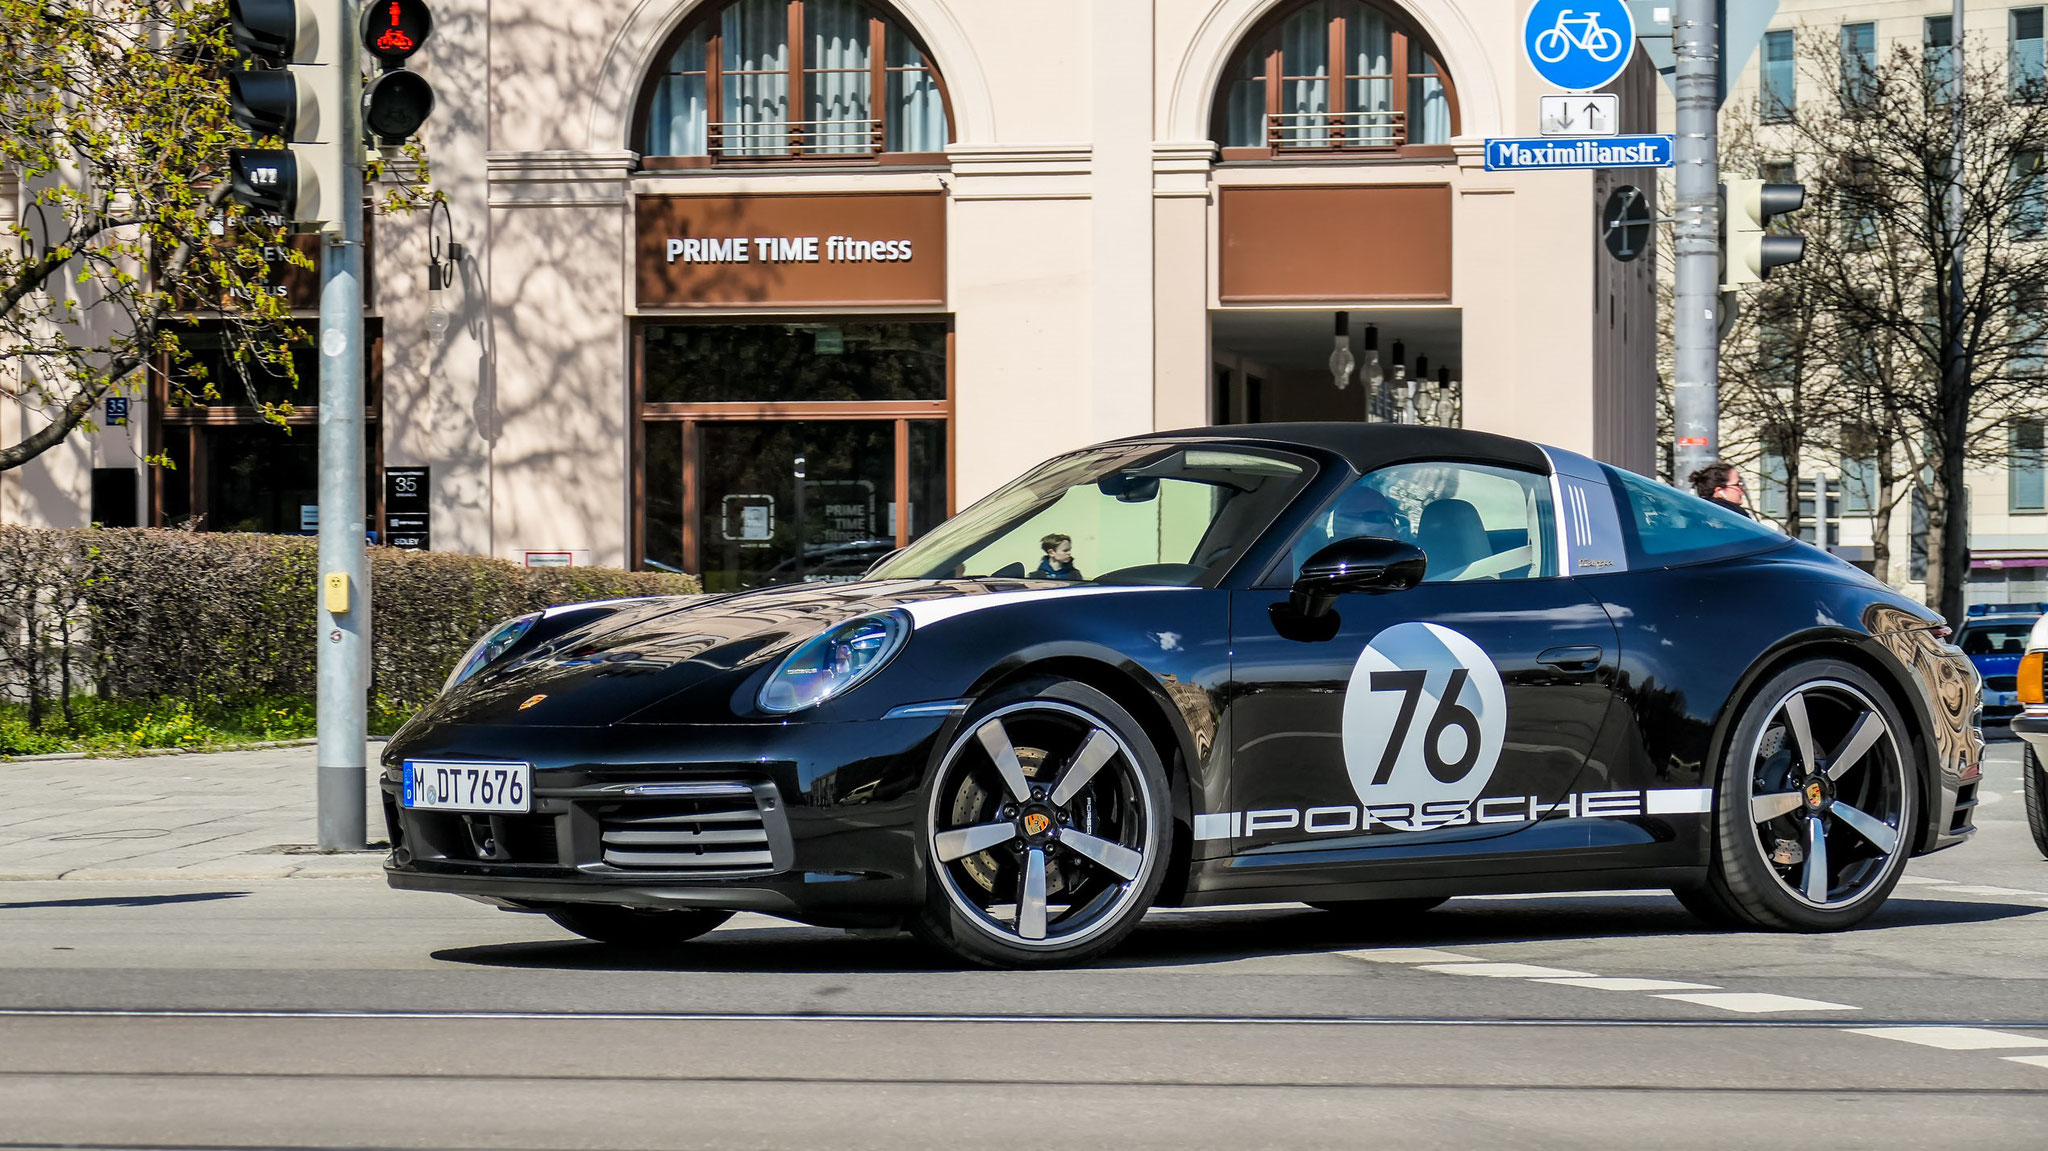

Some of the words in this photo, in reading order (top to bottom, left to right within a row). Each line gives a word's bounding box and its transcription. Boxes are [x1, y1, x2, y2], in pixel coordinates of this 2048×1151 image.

[1498, 142, 1661, 166] Maximilianstr.
[666, 238, 749, 262] PRIME
[754, 237, 819, 261] TIME
[826, 235, 912, 261] fitness
[108, 399, 125, 412] 35
[395, 477, 417, 491] 35
[825, 504, 865, 516] PRIME
[834, 518, 865, 530] TIME
[1369, 668, 1482, 786] 76
[406, 789, 412, 800] D
[413, 767, 425, 802] M
[437, 768, 462, 803] DT
[467, 769, 523, 805] 7676
[1245, 790, 1641, 837] PORSCHE
